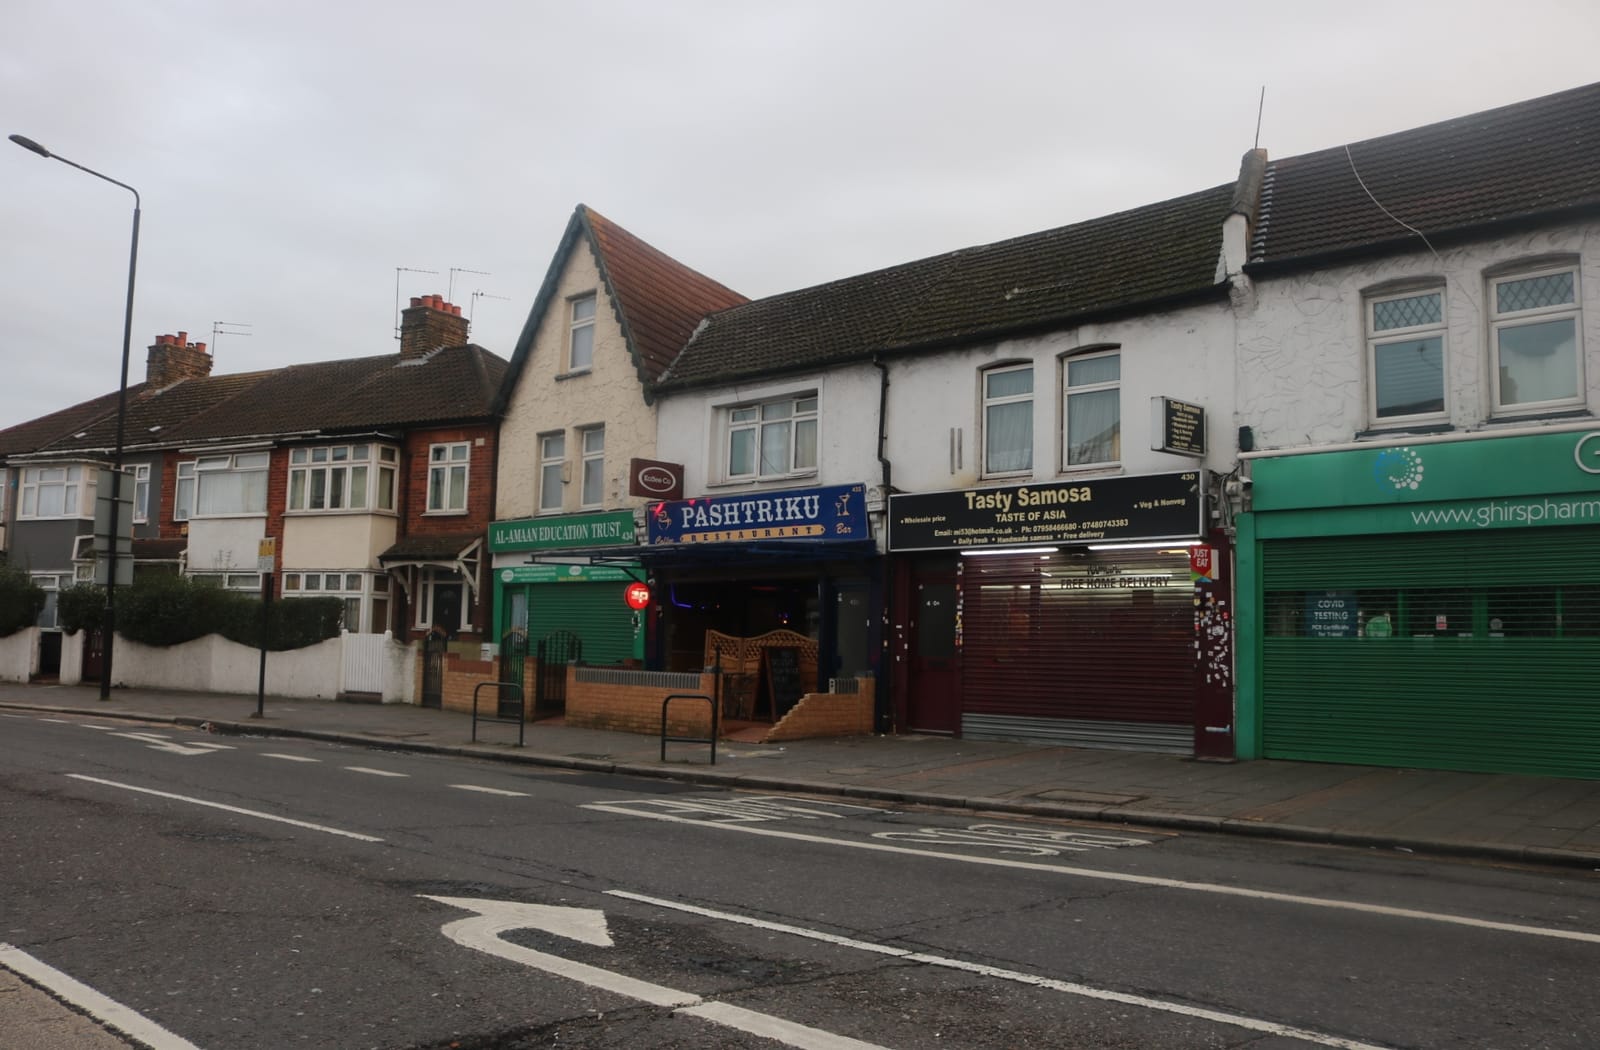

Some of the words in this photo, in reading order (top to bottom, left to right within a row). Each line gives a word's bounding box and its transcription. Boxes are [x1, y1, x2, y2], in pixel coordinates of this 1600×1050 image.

[964, 490, 1013, 512] Tasty
[1018, 486, 1092, 507] Samosa
[1139, 500, 1152, 510] Veg
[1153, 499, 1159, 507] &
[681, 495, 820, 529] PASHTRIKU
[995, 512, 1025, 523] TASTE
[1027, 512, 1041, 522] OF
[1043, 510, 1067, 521] ASIA
[904, 516, 931, 524] Wholesale
[932, 515, 946, 524] price
[495, 528, 539, 544] AL-AMAAN
[539, 523, 589, 542] EDUCATION
[591, 521, 621, 539] TRUST
[690, 526, 814, 542] RESTAURANT
[835, 522, 853, 535] Bar
[621, 531, 633, 541] 434
[1063, 532, 1077, 540] Free
[1078, 531, 1105, 539] delivery
[1193, 548, 1208, 558] JUST
[1196, 557, 1209, 567] EAT
[1061, 578, 1086, 589] FREE
[1087, 577, 1117, 589] HOME
[1119, 576, 1170, 589] DELIVERY
[1317, 599, 1345, 609] COVID
[1313, 611, 1349, 621] TESTING
